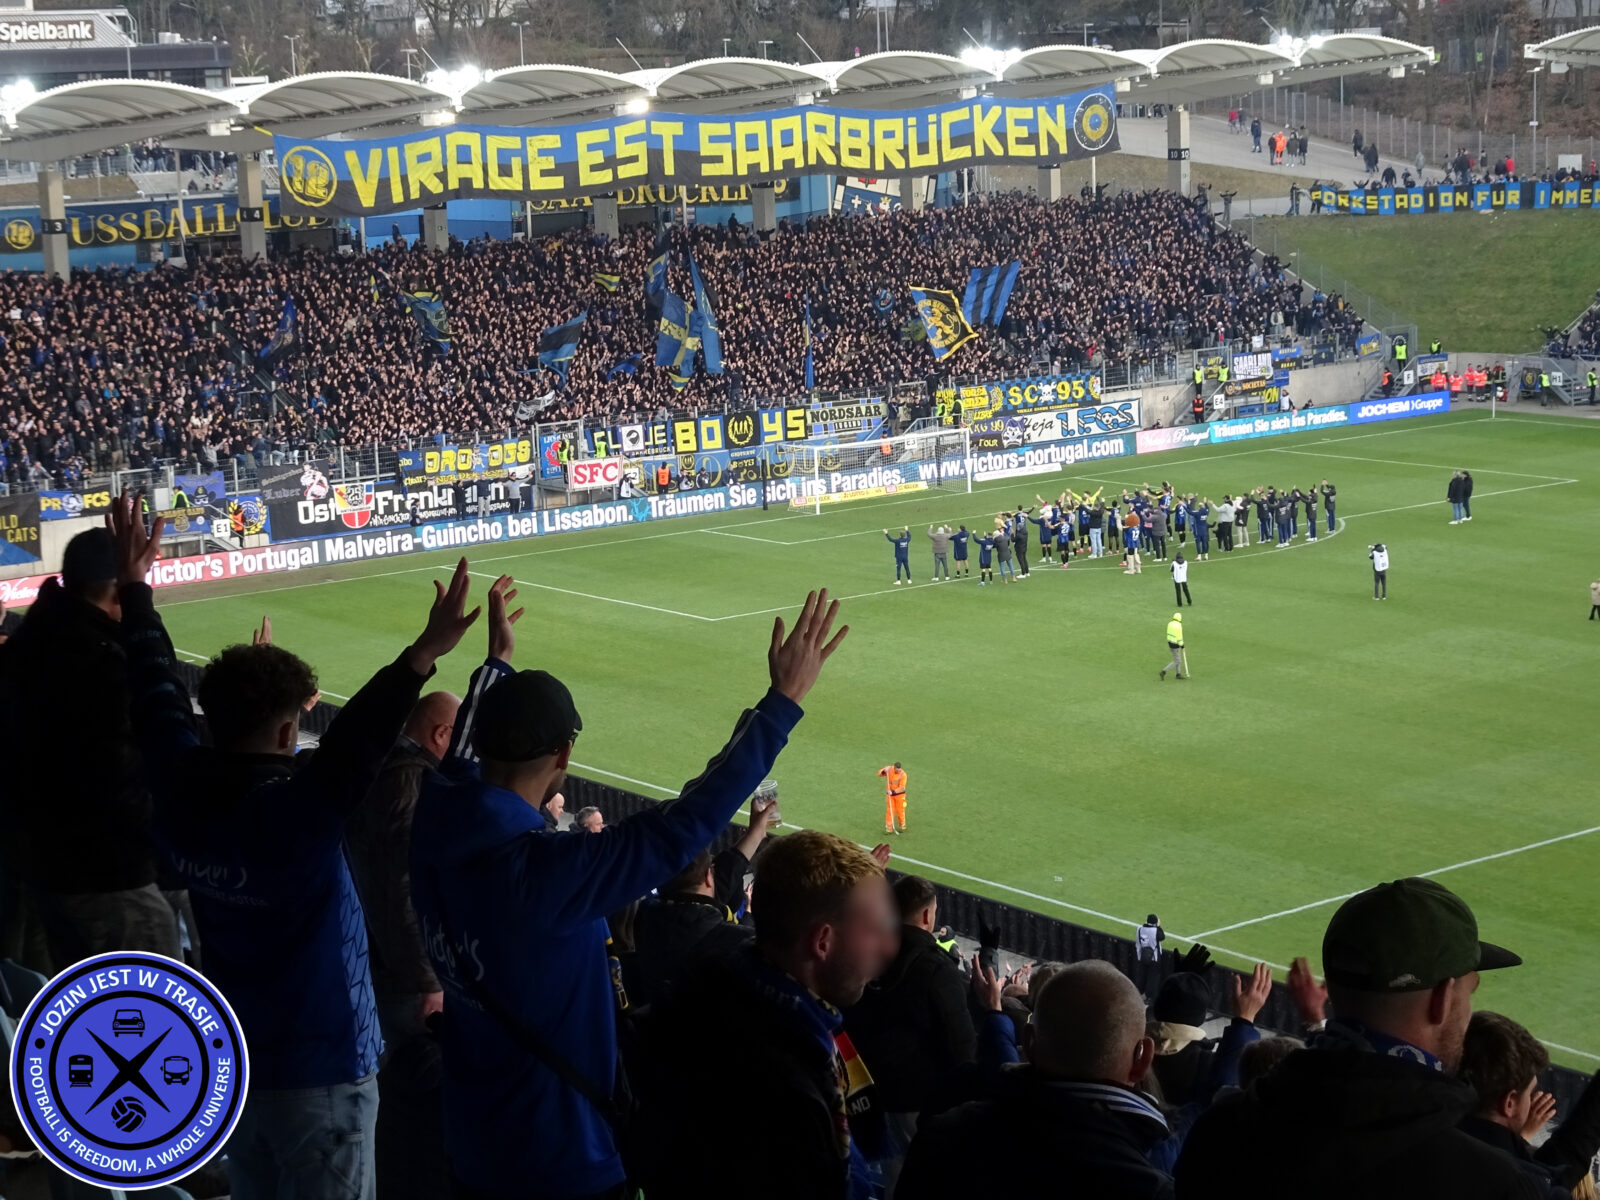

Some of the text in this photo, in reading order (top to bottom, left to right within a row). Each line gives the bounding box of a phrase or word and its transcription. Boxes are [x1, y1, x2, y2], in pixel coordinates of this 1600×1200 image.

[0, 20, 93, 42] Spielbank
[344, 103, 1069, 208] VIRAGE EST SAARBRÜCKEN
[1311, 190, 1469, 210] PARKSTADION
[253, 209, 261, 219] 4
[1008, 384, 1038, 406] SC
[1056, 379, 1085, 401] 95
[809, 404, 882, 423] NORDSAAR
[1357, 402, 1410, 419] JOCHEM
[1214, 409, 1347, 437] Träumen Sie sich ins Paradies.
[573, 461, 619, 485] SFC
[648, 467, 906, 519] Träumen Sie sich ins Paradies.
[0, 514, 19, 530] ILD
[216, 523, 228, 533] E1
[7, 527, 38, 543] CATS
[228, 540, 319, 570] Portugal
[325, 519, 503, 566] Malveira-Guincho
[508, 511, 538, 538] bei
[543, 503, 633, 530] Lissabon.
